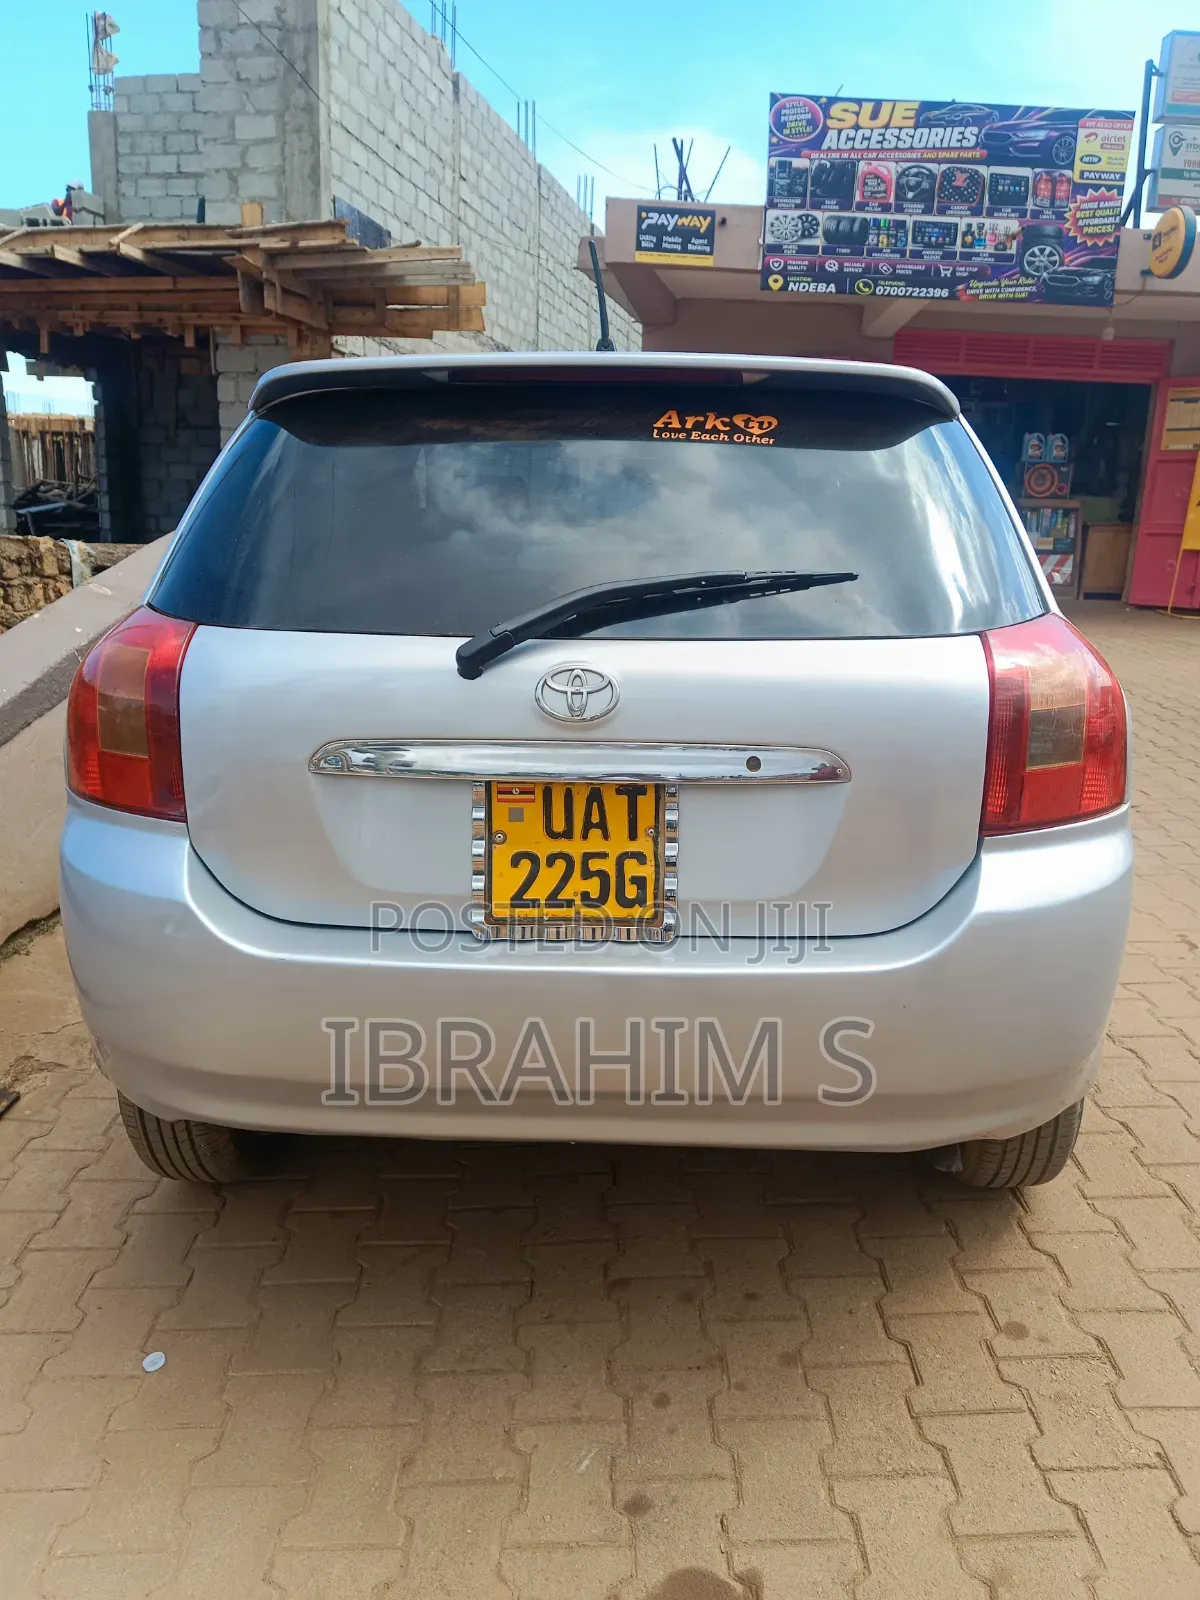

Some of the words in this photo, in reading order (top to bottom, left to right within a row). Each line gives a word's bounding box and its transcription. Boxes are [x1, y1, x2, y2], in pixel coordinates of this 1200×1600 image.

[826, 101, 920, 129] SUE
[821, 126, 979, 150] ACCESSORIES
[1101, 133, 1126, 143] airtel
[1083, 171, 1121, 180] PAYWAY
[1099, 200, 1122, 208] RANGE
[1076, 210, 1094, 218] BEST
[641, 211, 712, 233] PAYWAY
[1077, 216, 1120, 226] AFFORDABLE
[1082, 224, 1115, 234] PRICES!
[787, 282, 837, 294] NDEBA
[969, 279, 999, 289] Upgrade
[1000, 278, 1017, 288] Your
[875, 285, 950, 298] 0700722396
[966, 287, 984, 295] DRIVE
[652, 410, 731, 431] Ark
[652, 429, 687, 439] Love
[689, 431, 730, 441] Each
[733, 433, 776, 444] Other
[543, 785, 648, 841] UAT
[510, 851, 648, 909] 225G
